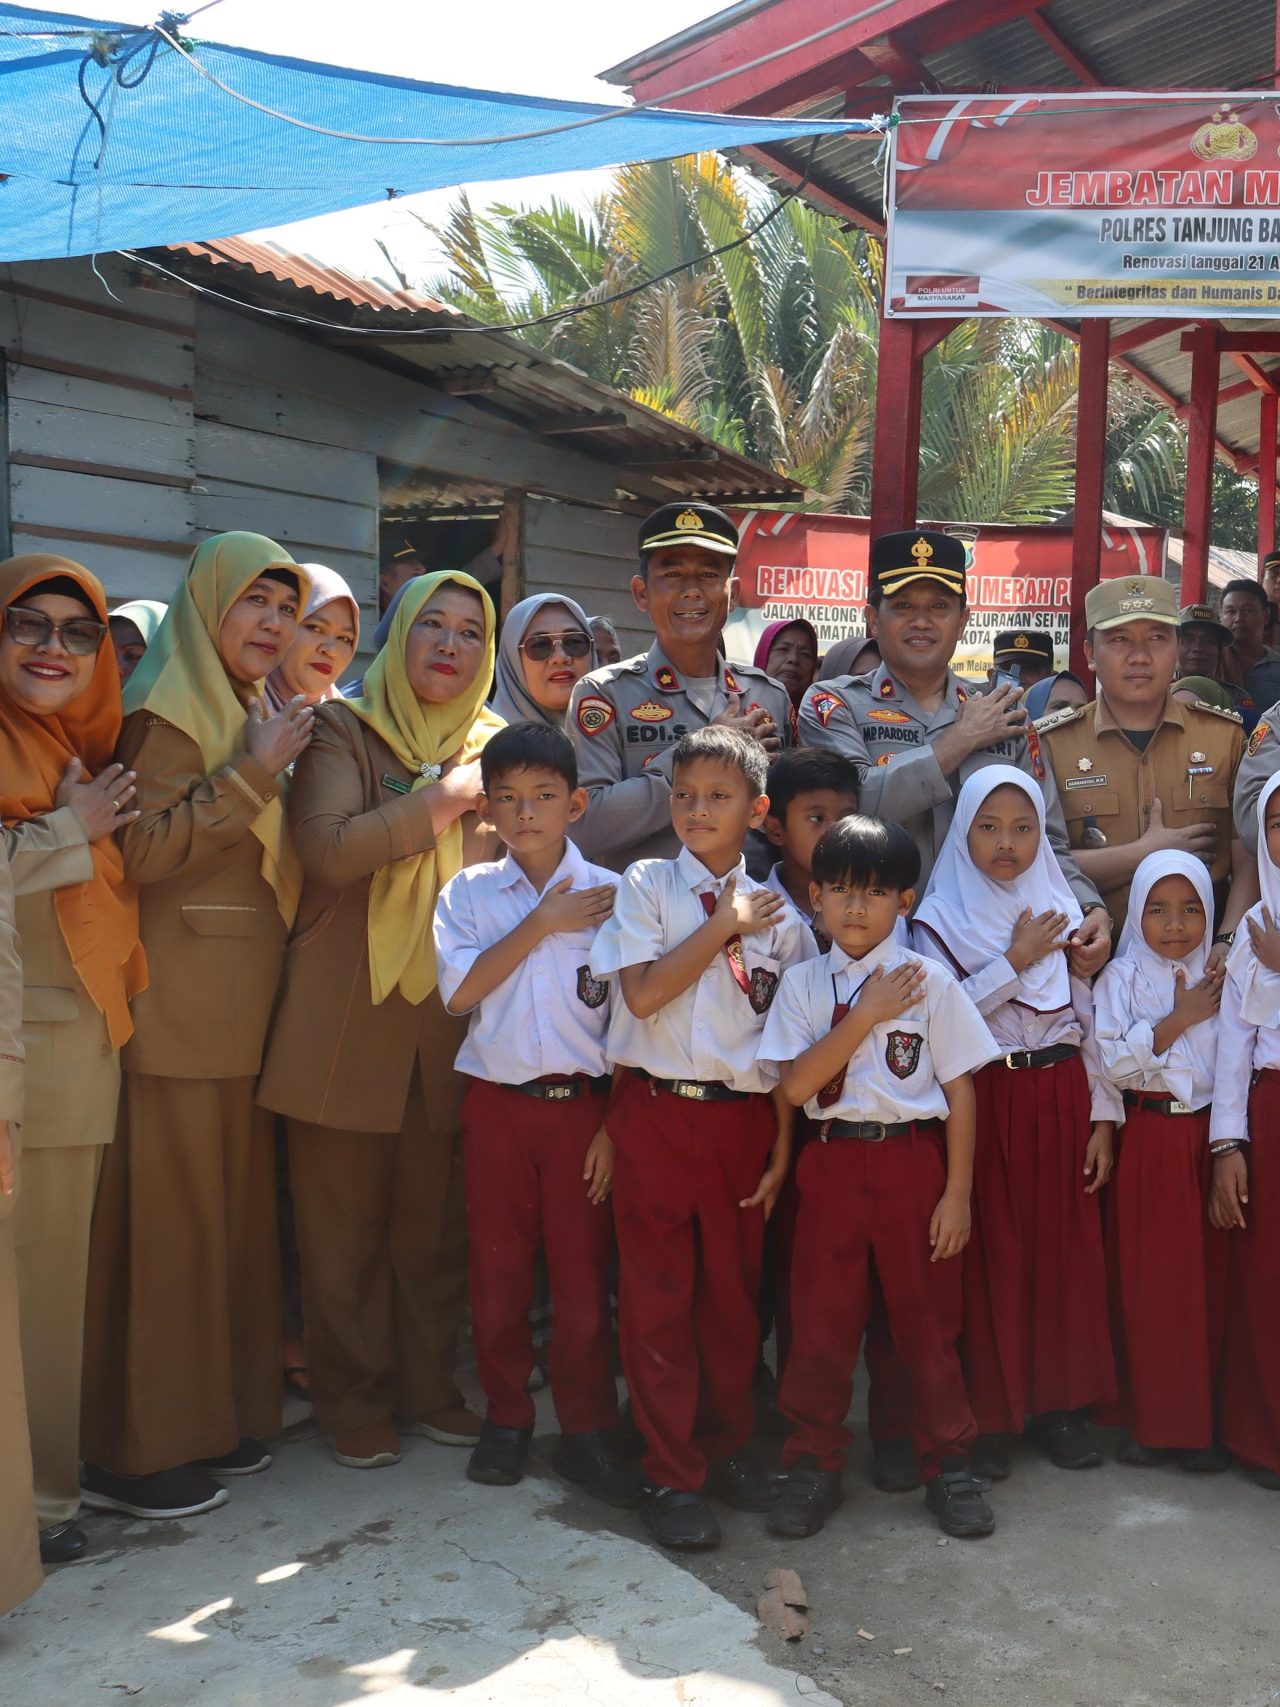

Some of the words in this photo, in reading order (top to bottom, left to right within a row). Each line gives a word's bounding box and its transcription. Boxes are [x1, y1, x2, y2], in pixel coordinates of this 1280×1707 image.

[1026, 170, 1233, 206] JEMBATAN
[1100, 217, 1167, 244] POLRES
[1172, 216, 1254, 243] TANJUNG
[1123, 254, 1186, 270] Renovasi
[1191, 254, 1244, 271] tanggal
[1247, 255, 1265, 270] 21
[1076, 285, 1167, 300] Berintegritas
[1171, 285, 1197, 300] dan
[1201, 285, 1263, 300] Humanis
[757, 565, 864, 601] RENOVASI
[980, 576, 1054, 607] MERAH
[763, 603, 804, 620] JALAN
[807, 605, 858, 623] KELONG
[968, 611, 1031, 628] ELURAHAN
[1034, 612, 1054, 628] SEI
[815, 624, 865, 641] AMATAN
[961, 630, 991, 645] KOTA
[878, 726, 920, 743] PARDEDE
